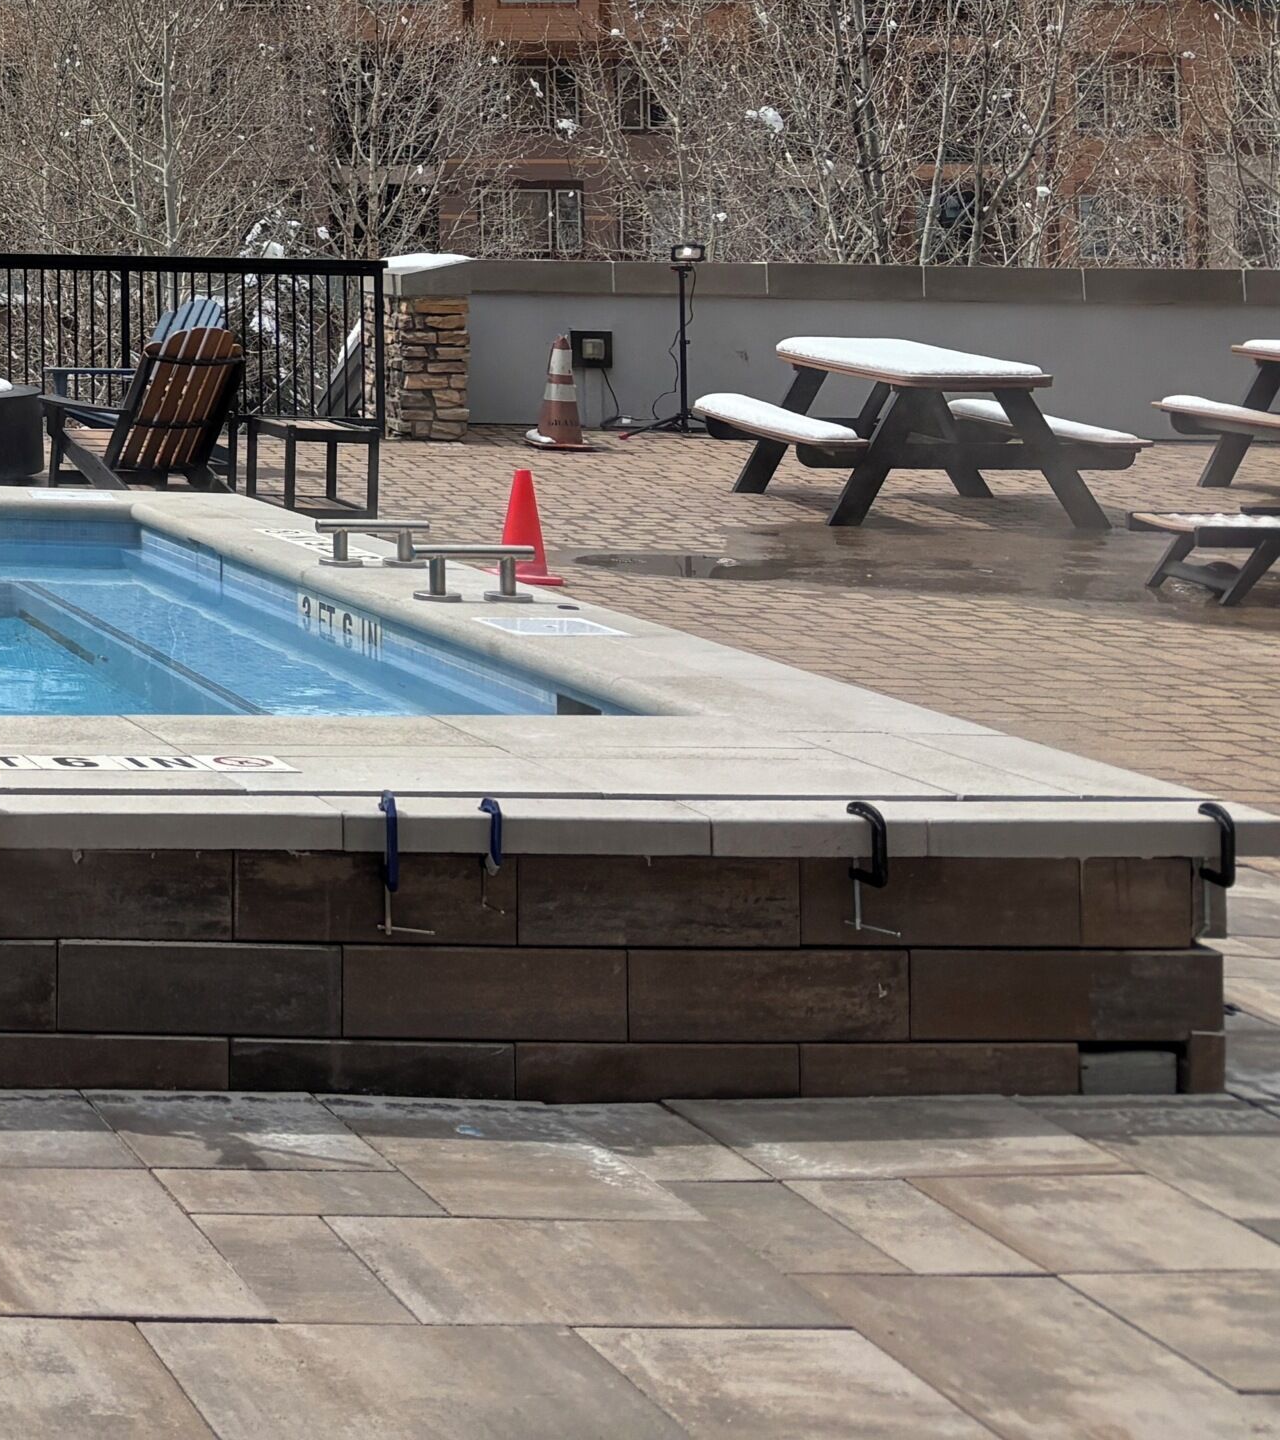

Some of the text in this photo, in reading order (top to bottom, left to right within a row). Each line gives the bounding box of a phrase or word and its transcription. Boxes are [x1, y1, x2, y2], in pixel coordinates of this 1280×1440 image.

[361, 617, 377, 649] IN
[52, 757, 100, 768] 6
[124, 757, 198, 769] IN
